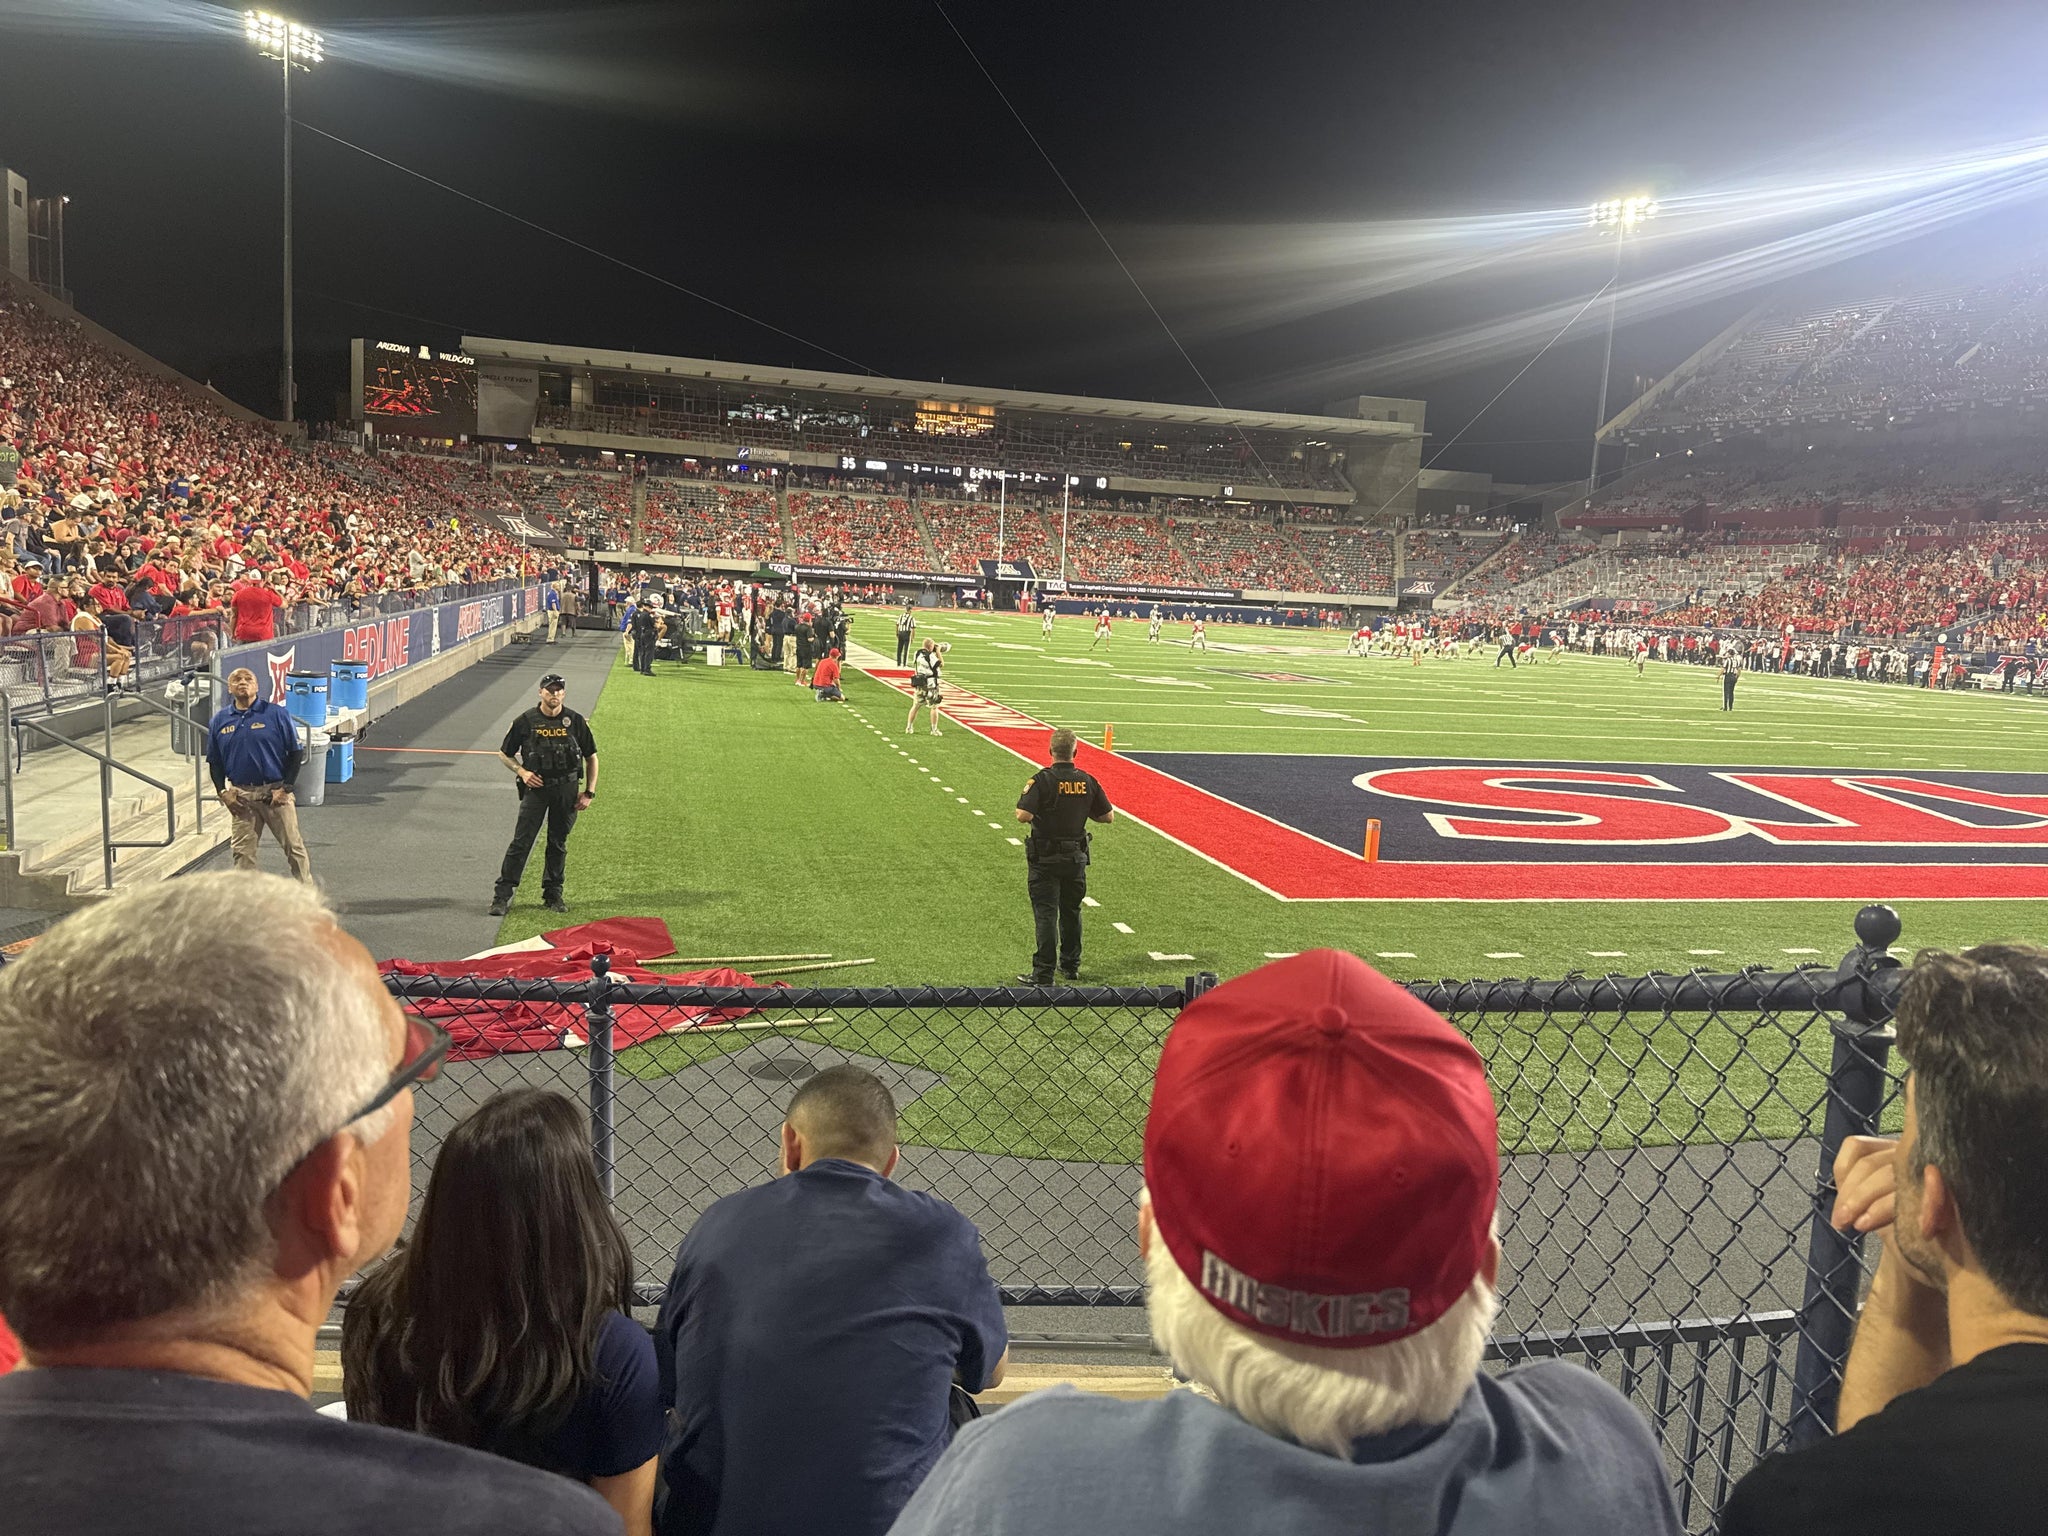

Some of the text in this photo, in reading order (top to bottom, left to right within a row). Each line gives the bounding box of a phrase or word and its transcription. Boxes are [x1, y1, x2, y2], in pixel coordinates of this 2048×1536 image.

[376, 341, 410, 354] ARIZONA
[439, 352, 475, 365] WILDCATS
[842, 456, 856, 470] 35
[912, 463, 919, 474] 3
[934, 465, 939, 475] 1
[952, 466, 962, 477] 10
[969, 467, 992, 480] 6:24
[1019, 472, 1026, 482] 3
[1034, 472, 1041, 483] 2
[1096, 477, 1107, 489] 10
[1224, 486, 1233, 496] 10
[343, 615, 410, 681] REDLINE
[221, 724, 235, 735] 410
[536, 728, 568, 737] POLICE
[1058, 781, 1087, 794] POLICE
[1200, 1248, 1411, 1338] HUSKIES
